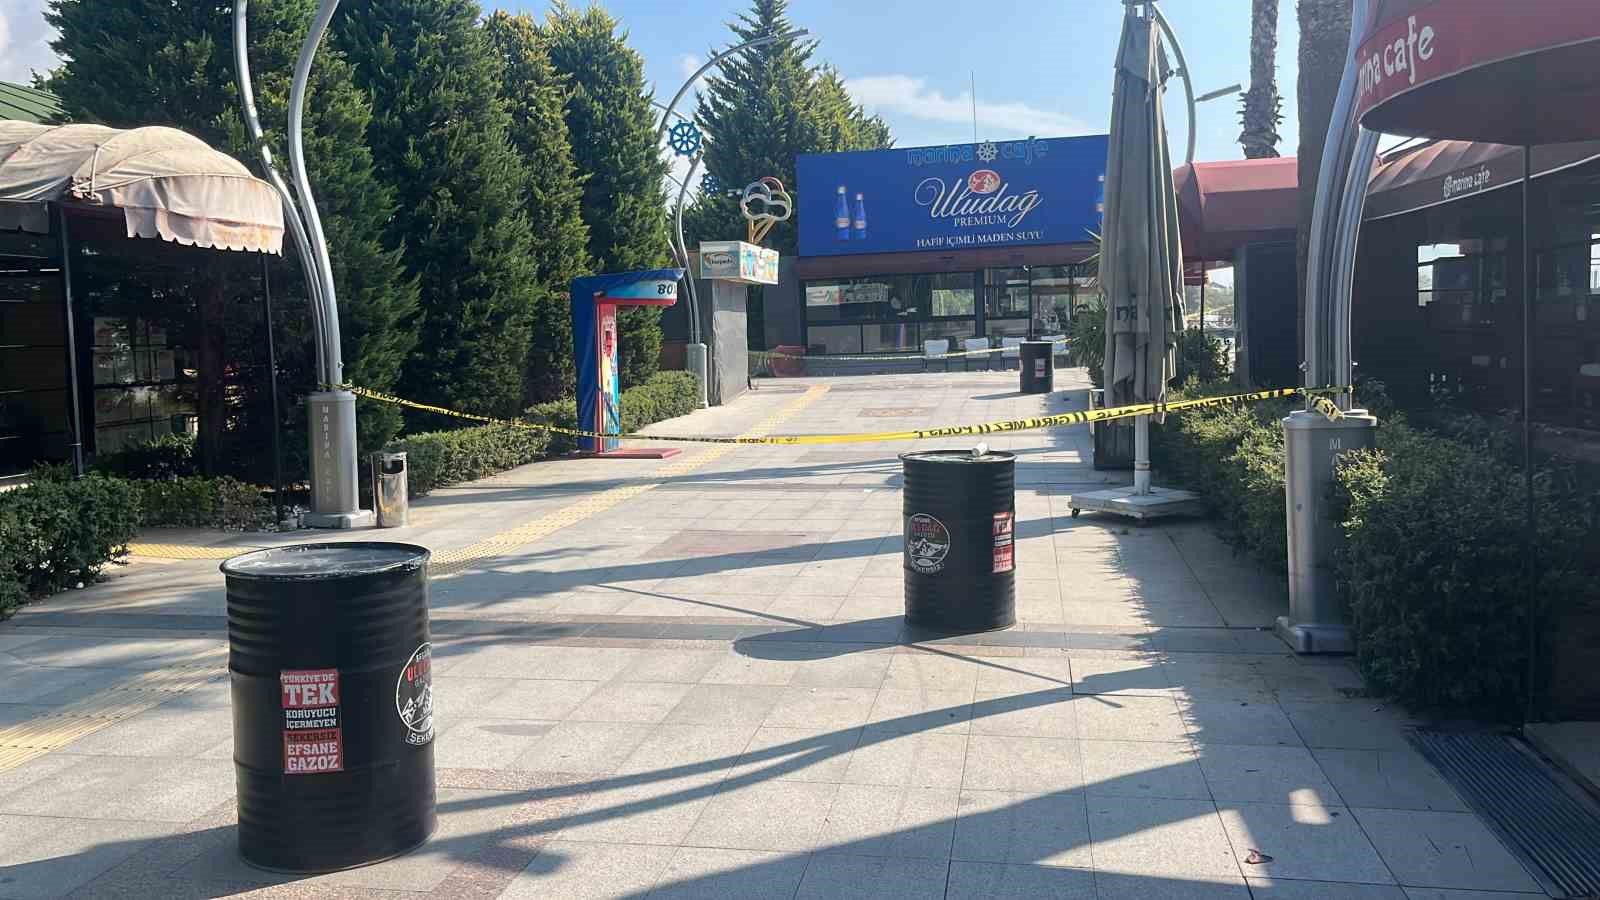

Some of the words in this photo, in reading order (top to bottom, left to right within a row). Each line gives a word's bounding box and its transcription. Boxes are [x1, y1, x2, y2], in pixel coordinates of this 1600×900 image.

[1384, 16, 1434, 85] cafe
[904, 145, 973, 167] marina
[1001, 136, 1049, 165] cafe
[914, 177, 1044, 228] Uludağ
[954, 214, 1007, 228] PREMIUM
[977, 232, 1013, 244] MADEN
[1015, 230, 1045, 242] SUYU
[284, 682, 337, 705] TEK
[285, 708, 336, 719] KORUYUCU
[287, 742, 338, 756] EFSANE
[287, 755, 339, 770] GAZOZ
